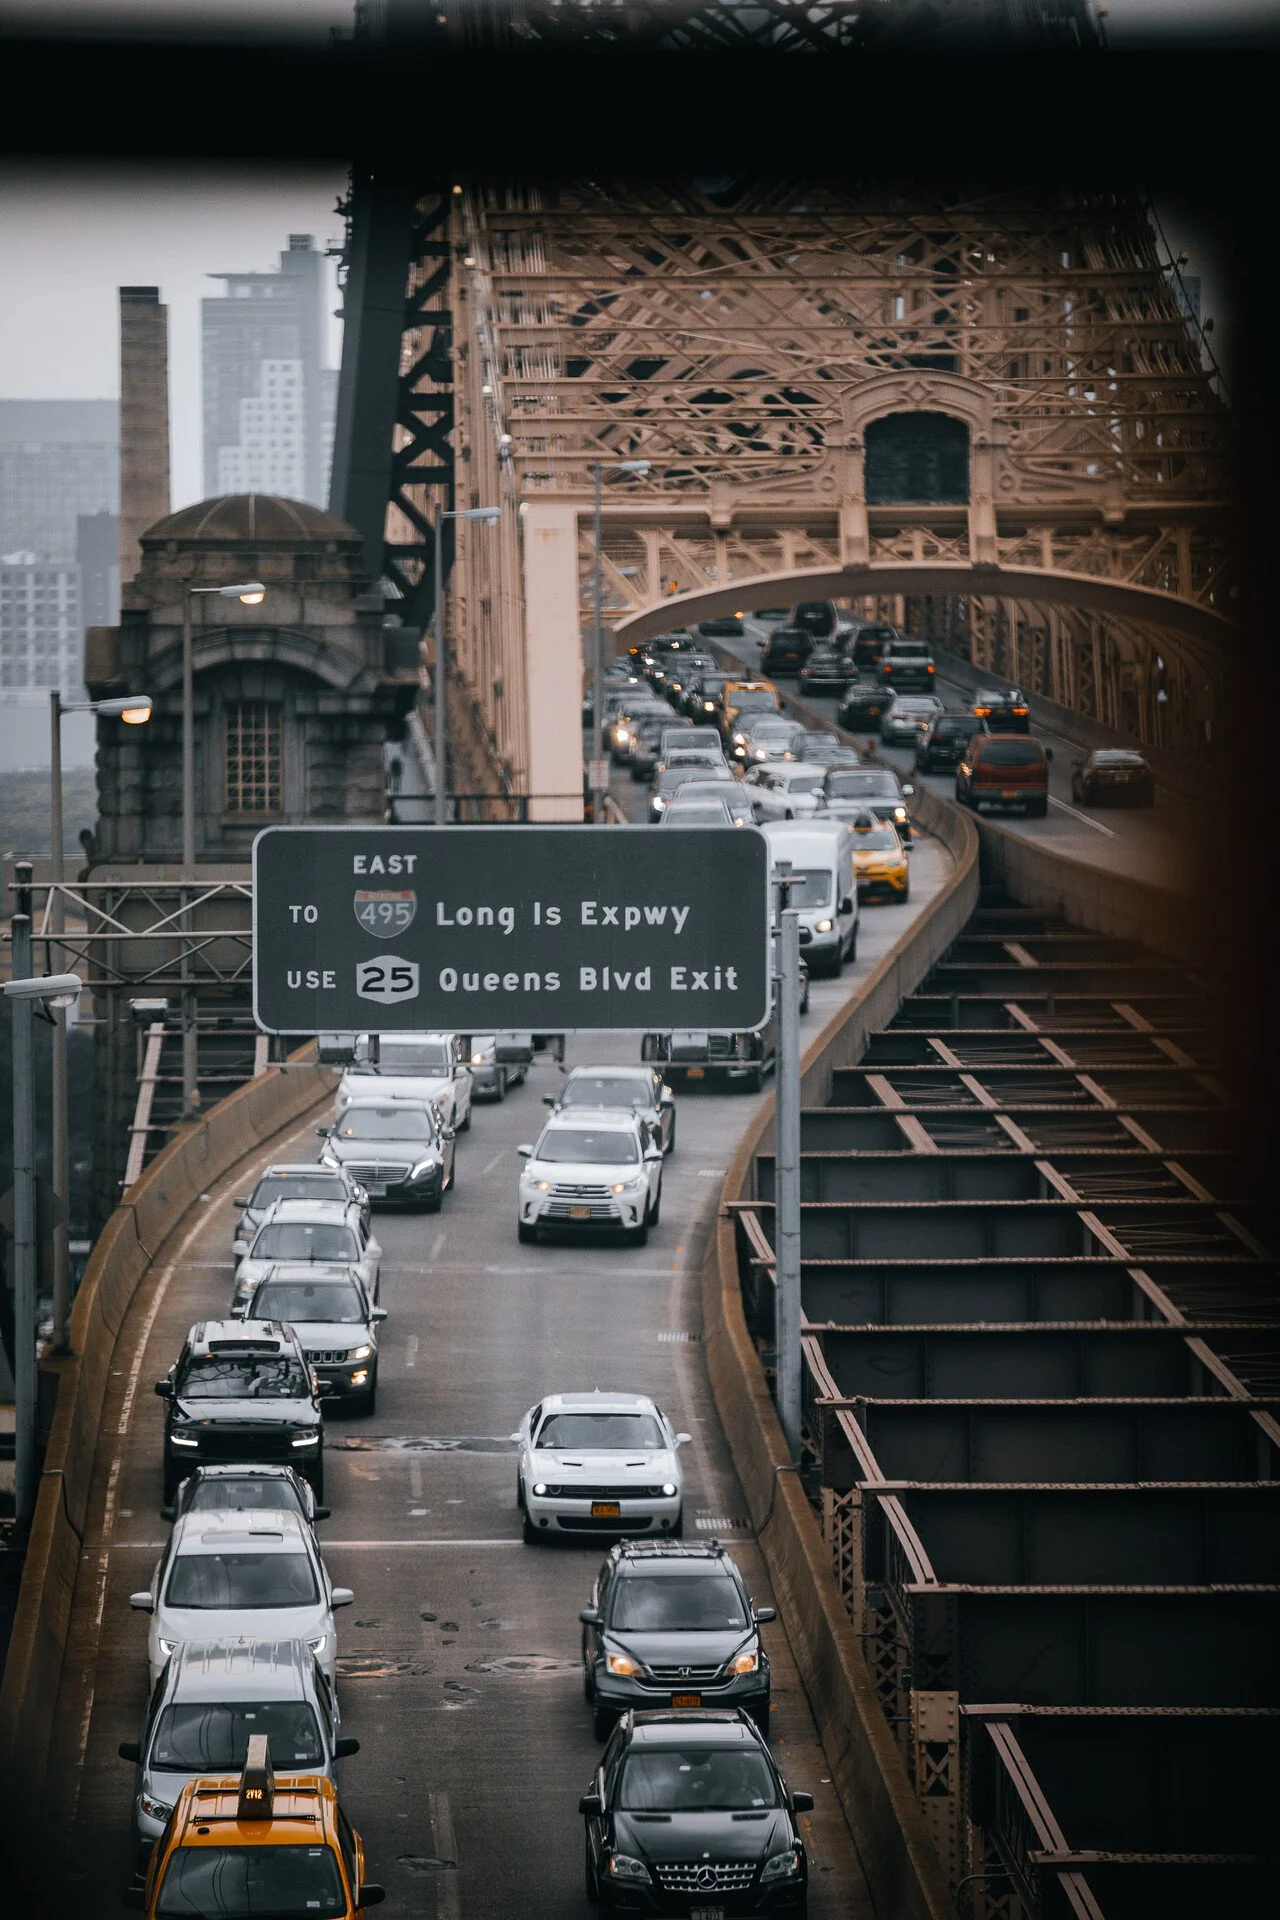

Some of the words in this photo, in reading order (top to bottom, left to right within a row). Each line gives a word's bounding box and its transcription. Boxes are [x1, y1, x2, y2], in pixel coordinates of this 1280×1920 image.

[353, 854, 418, 875] EAST
[288, 904, 318, 924] TO
[359, 902, 412, 926] 495
[436, 901, 515, 936] Long
[533, 901, 562, 926] Is
[581, 901, 691, 936] Expwy
[287, 970, 336, 989] USE
[361, 966, 414, 993] 25
[439, 967, 561, 992] Queens
[579, 966, 652, 991] Blvd
[670, 965, 739, 991] Exit
